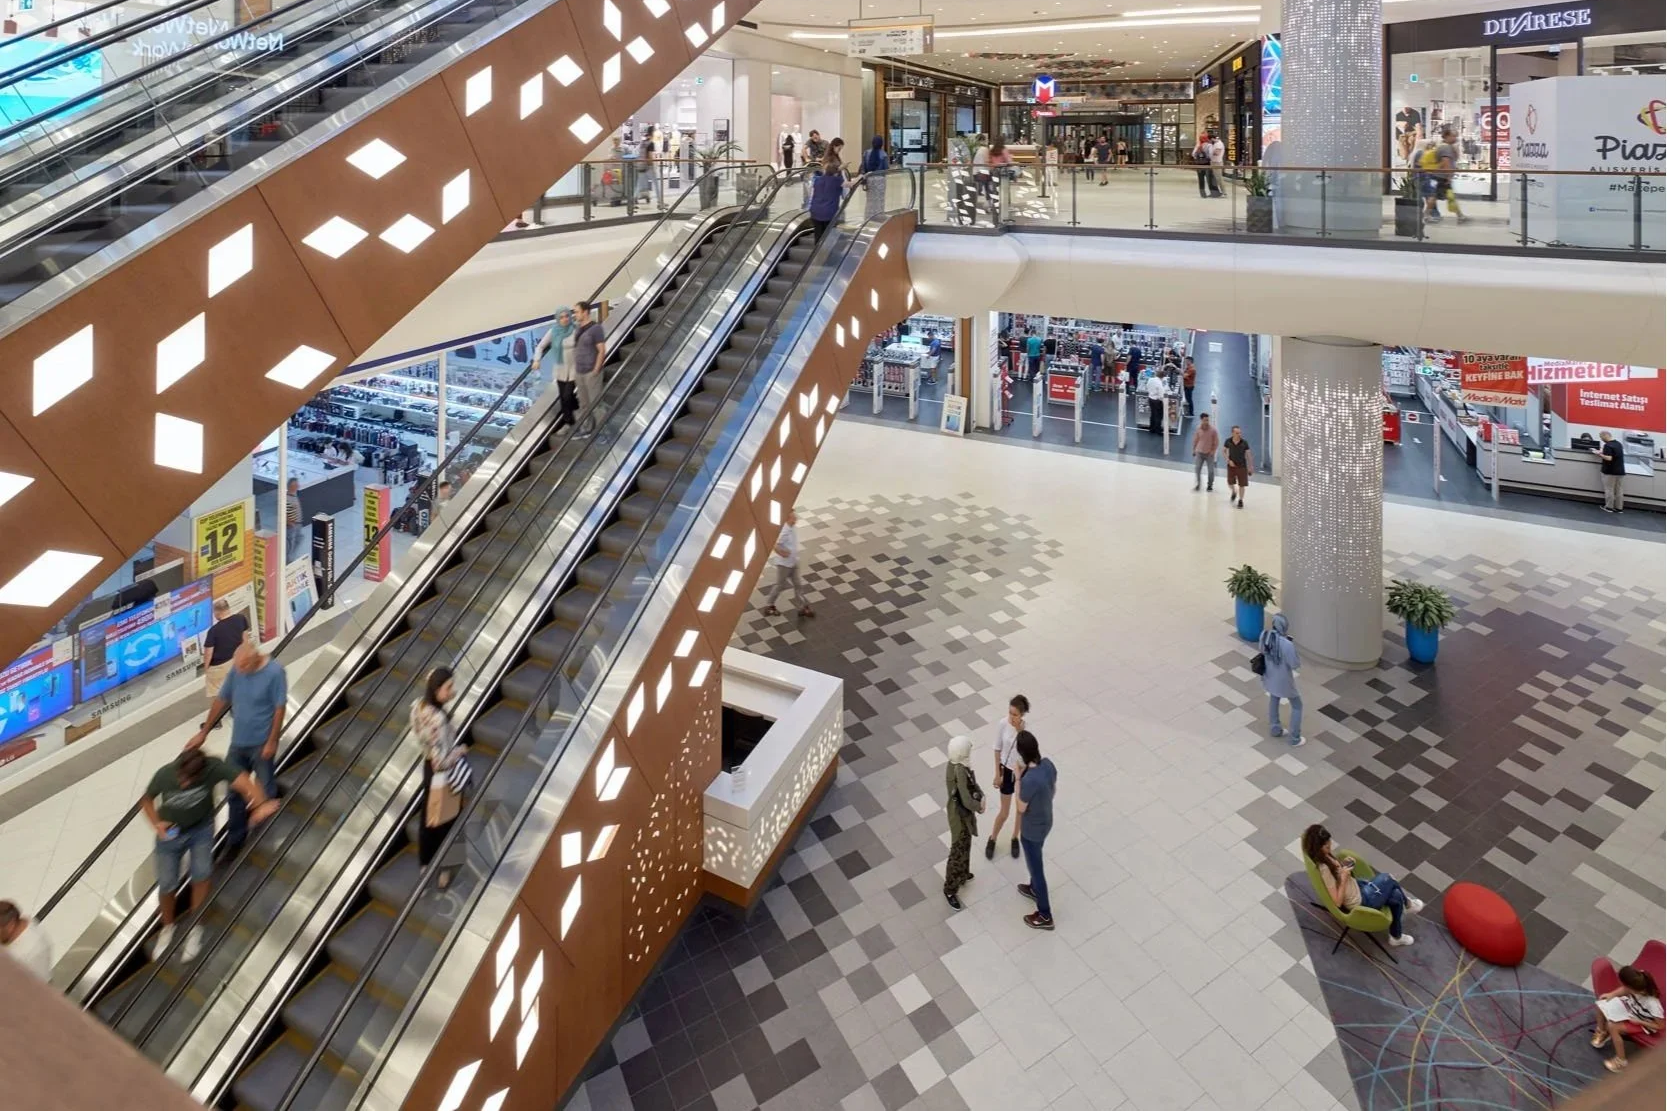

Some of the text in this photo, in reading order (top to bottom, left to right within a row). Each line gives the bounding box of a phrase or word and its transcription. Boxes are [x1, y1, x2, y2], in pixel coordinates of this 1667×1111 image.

[1483, 8, 1592, 37] DIVARESE
[1464, 355, 1475, 364] 10
[1504, 370, 1524, 380] BAK
[1527, 362, 1625, 380] Hizmetler
[1580, 398, 1619, 409] Teslimat
[205, 522, 238, 562] 12
[165, 659, 201, 680] SAMSUNG
[91, 694, 132, 719] SAMSUNG
